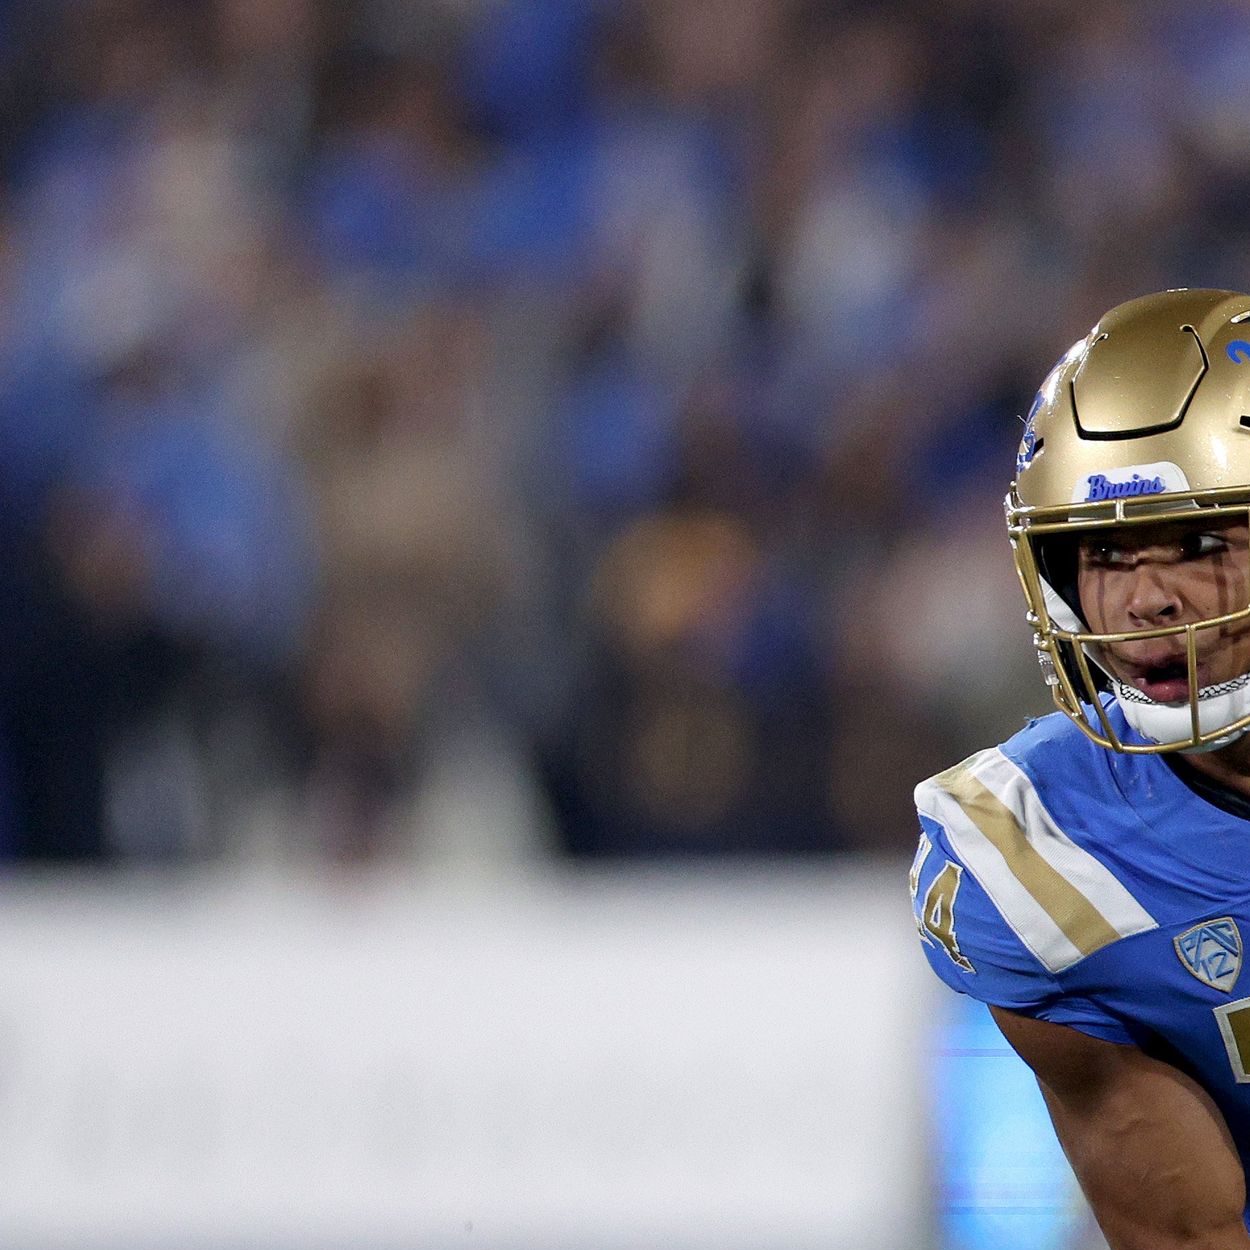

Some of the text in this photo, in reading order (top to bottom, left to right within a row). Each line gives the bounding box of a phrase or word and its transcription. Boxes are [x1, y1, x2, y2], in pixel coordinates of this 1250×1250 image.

[1085, 474, 1166, 502] Bruins
[1179, 921, 1239, 973] PAC
[1200, 951, 1235, 982] 12
